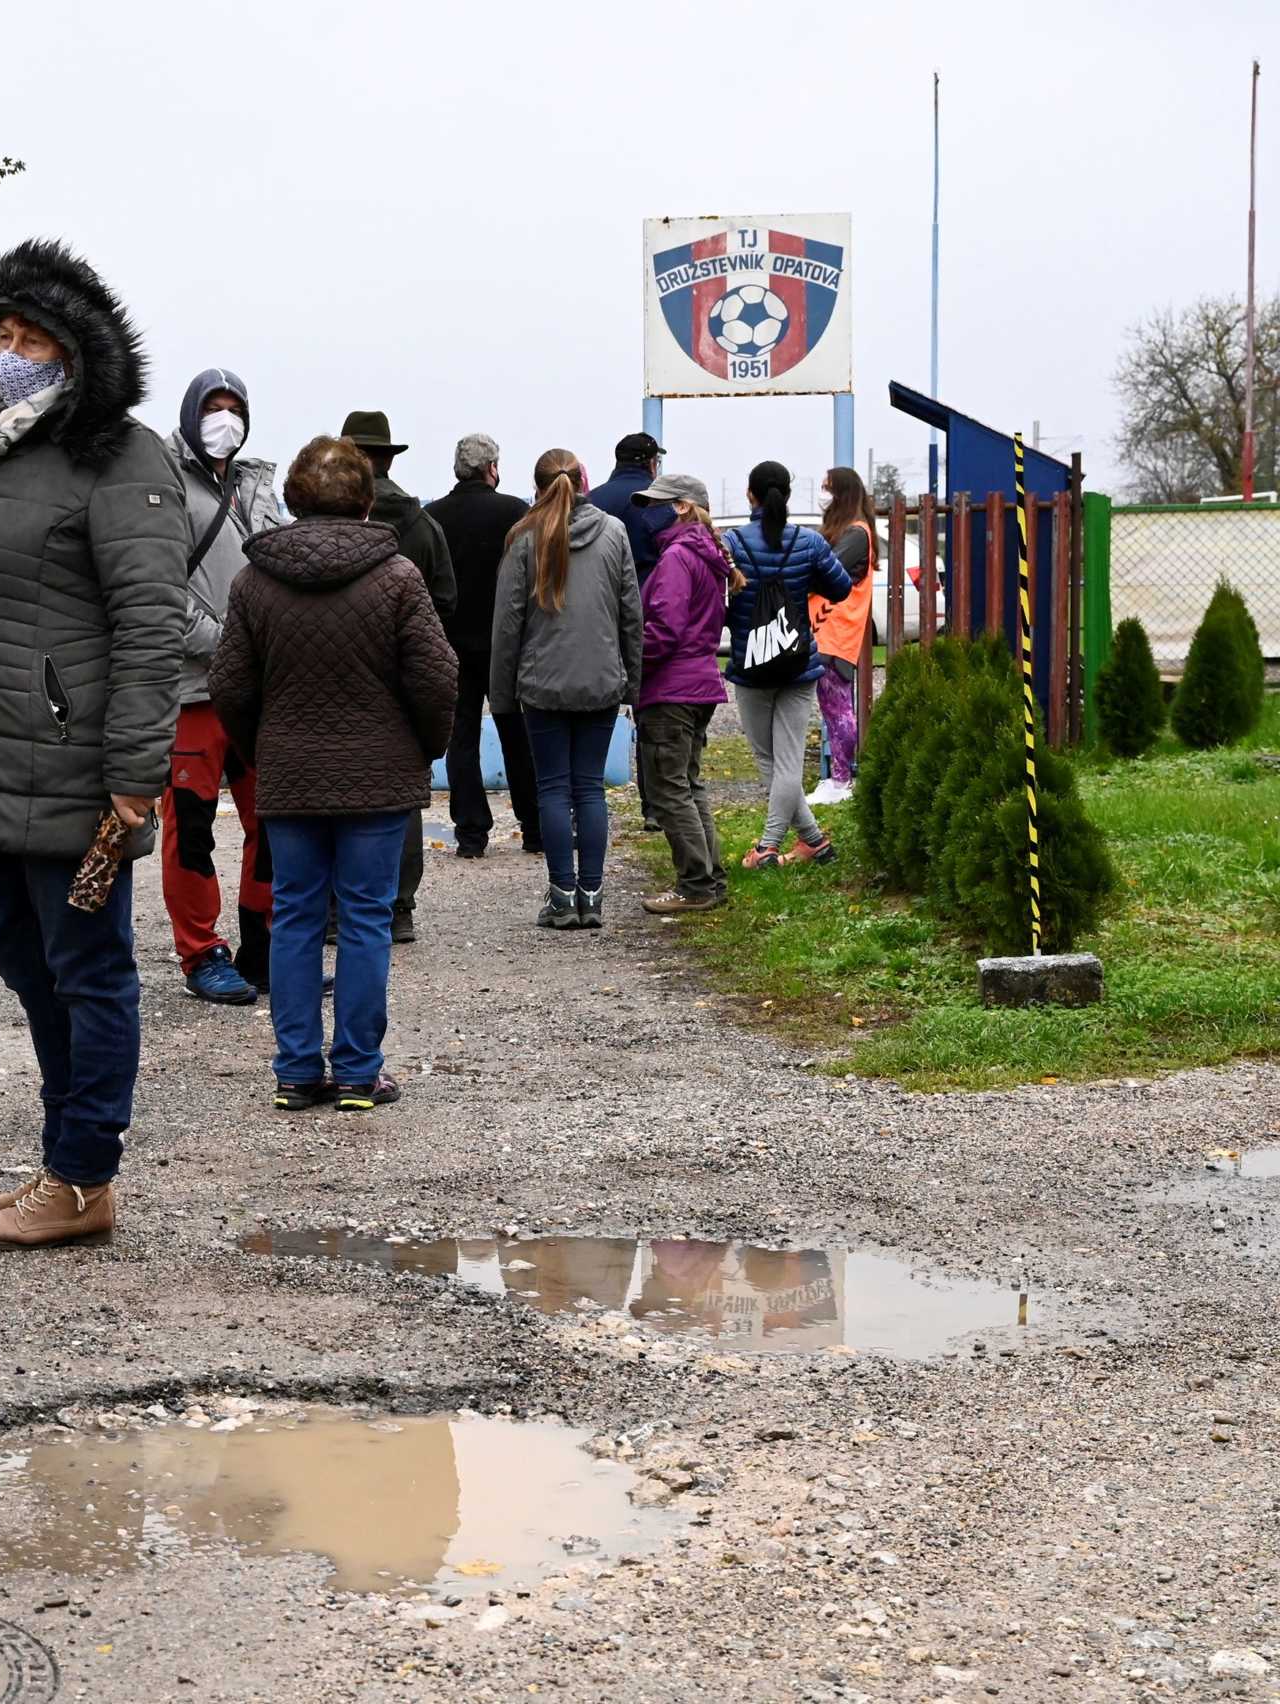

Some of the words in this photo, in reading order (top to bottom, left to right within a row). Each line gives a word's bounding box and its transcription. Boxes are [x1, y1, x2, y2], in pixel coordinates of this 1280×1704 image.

[738, 229, 757, 249] TJ
[773, 255, 844, 289] OPATOVÁ
[729, 359, 769, 379] 1951
[743, 606, 799, 670] NIKE
